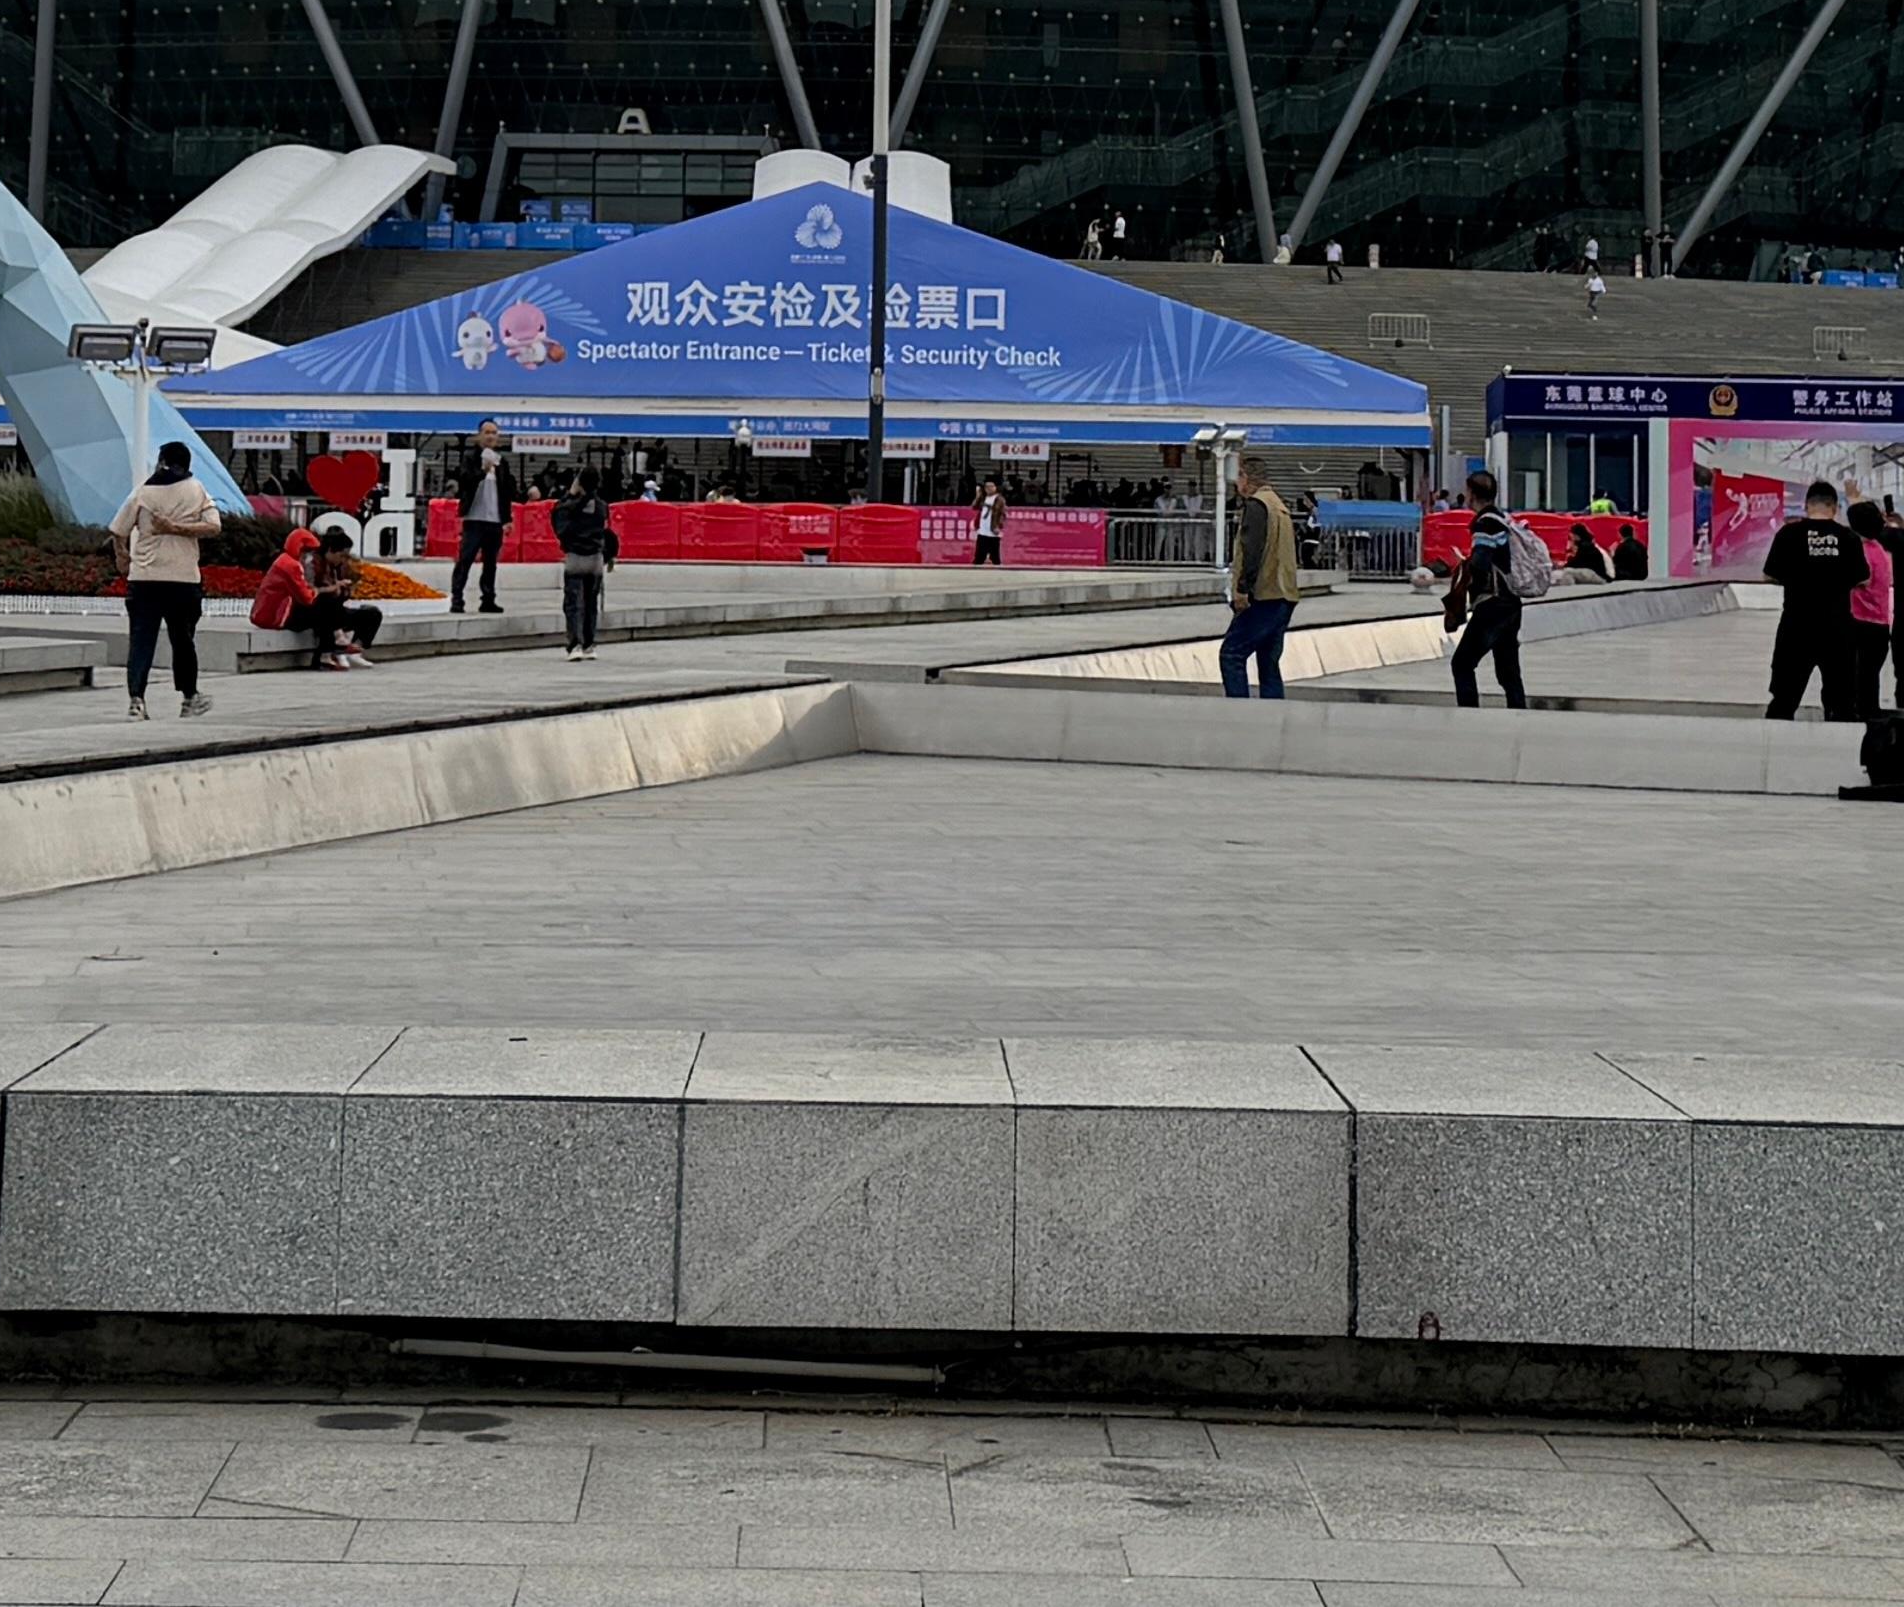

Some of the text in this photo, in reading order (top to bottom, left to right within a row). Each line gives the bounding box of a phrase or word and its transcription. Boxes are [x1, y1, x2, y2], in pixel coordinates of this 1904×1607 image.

[617, 107, 652, 134] A
[625, 280, 1006, 330] 观众安检及验票口
[577, 339, 680, 363] Spectator
[901, 343, 988, 371] Security
[995, 344, 1061, 367] Check
